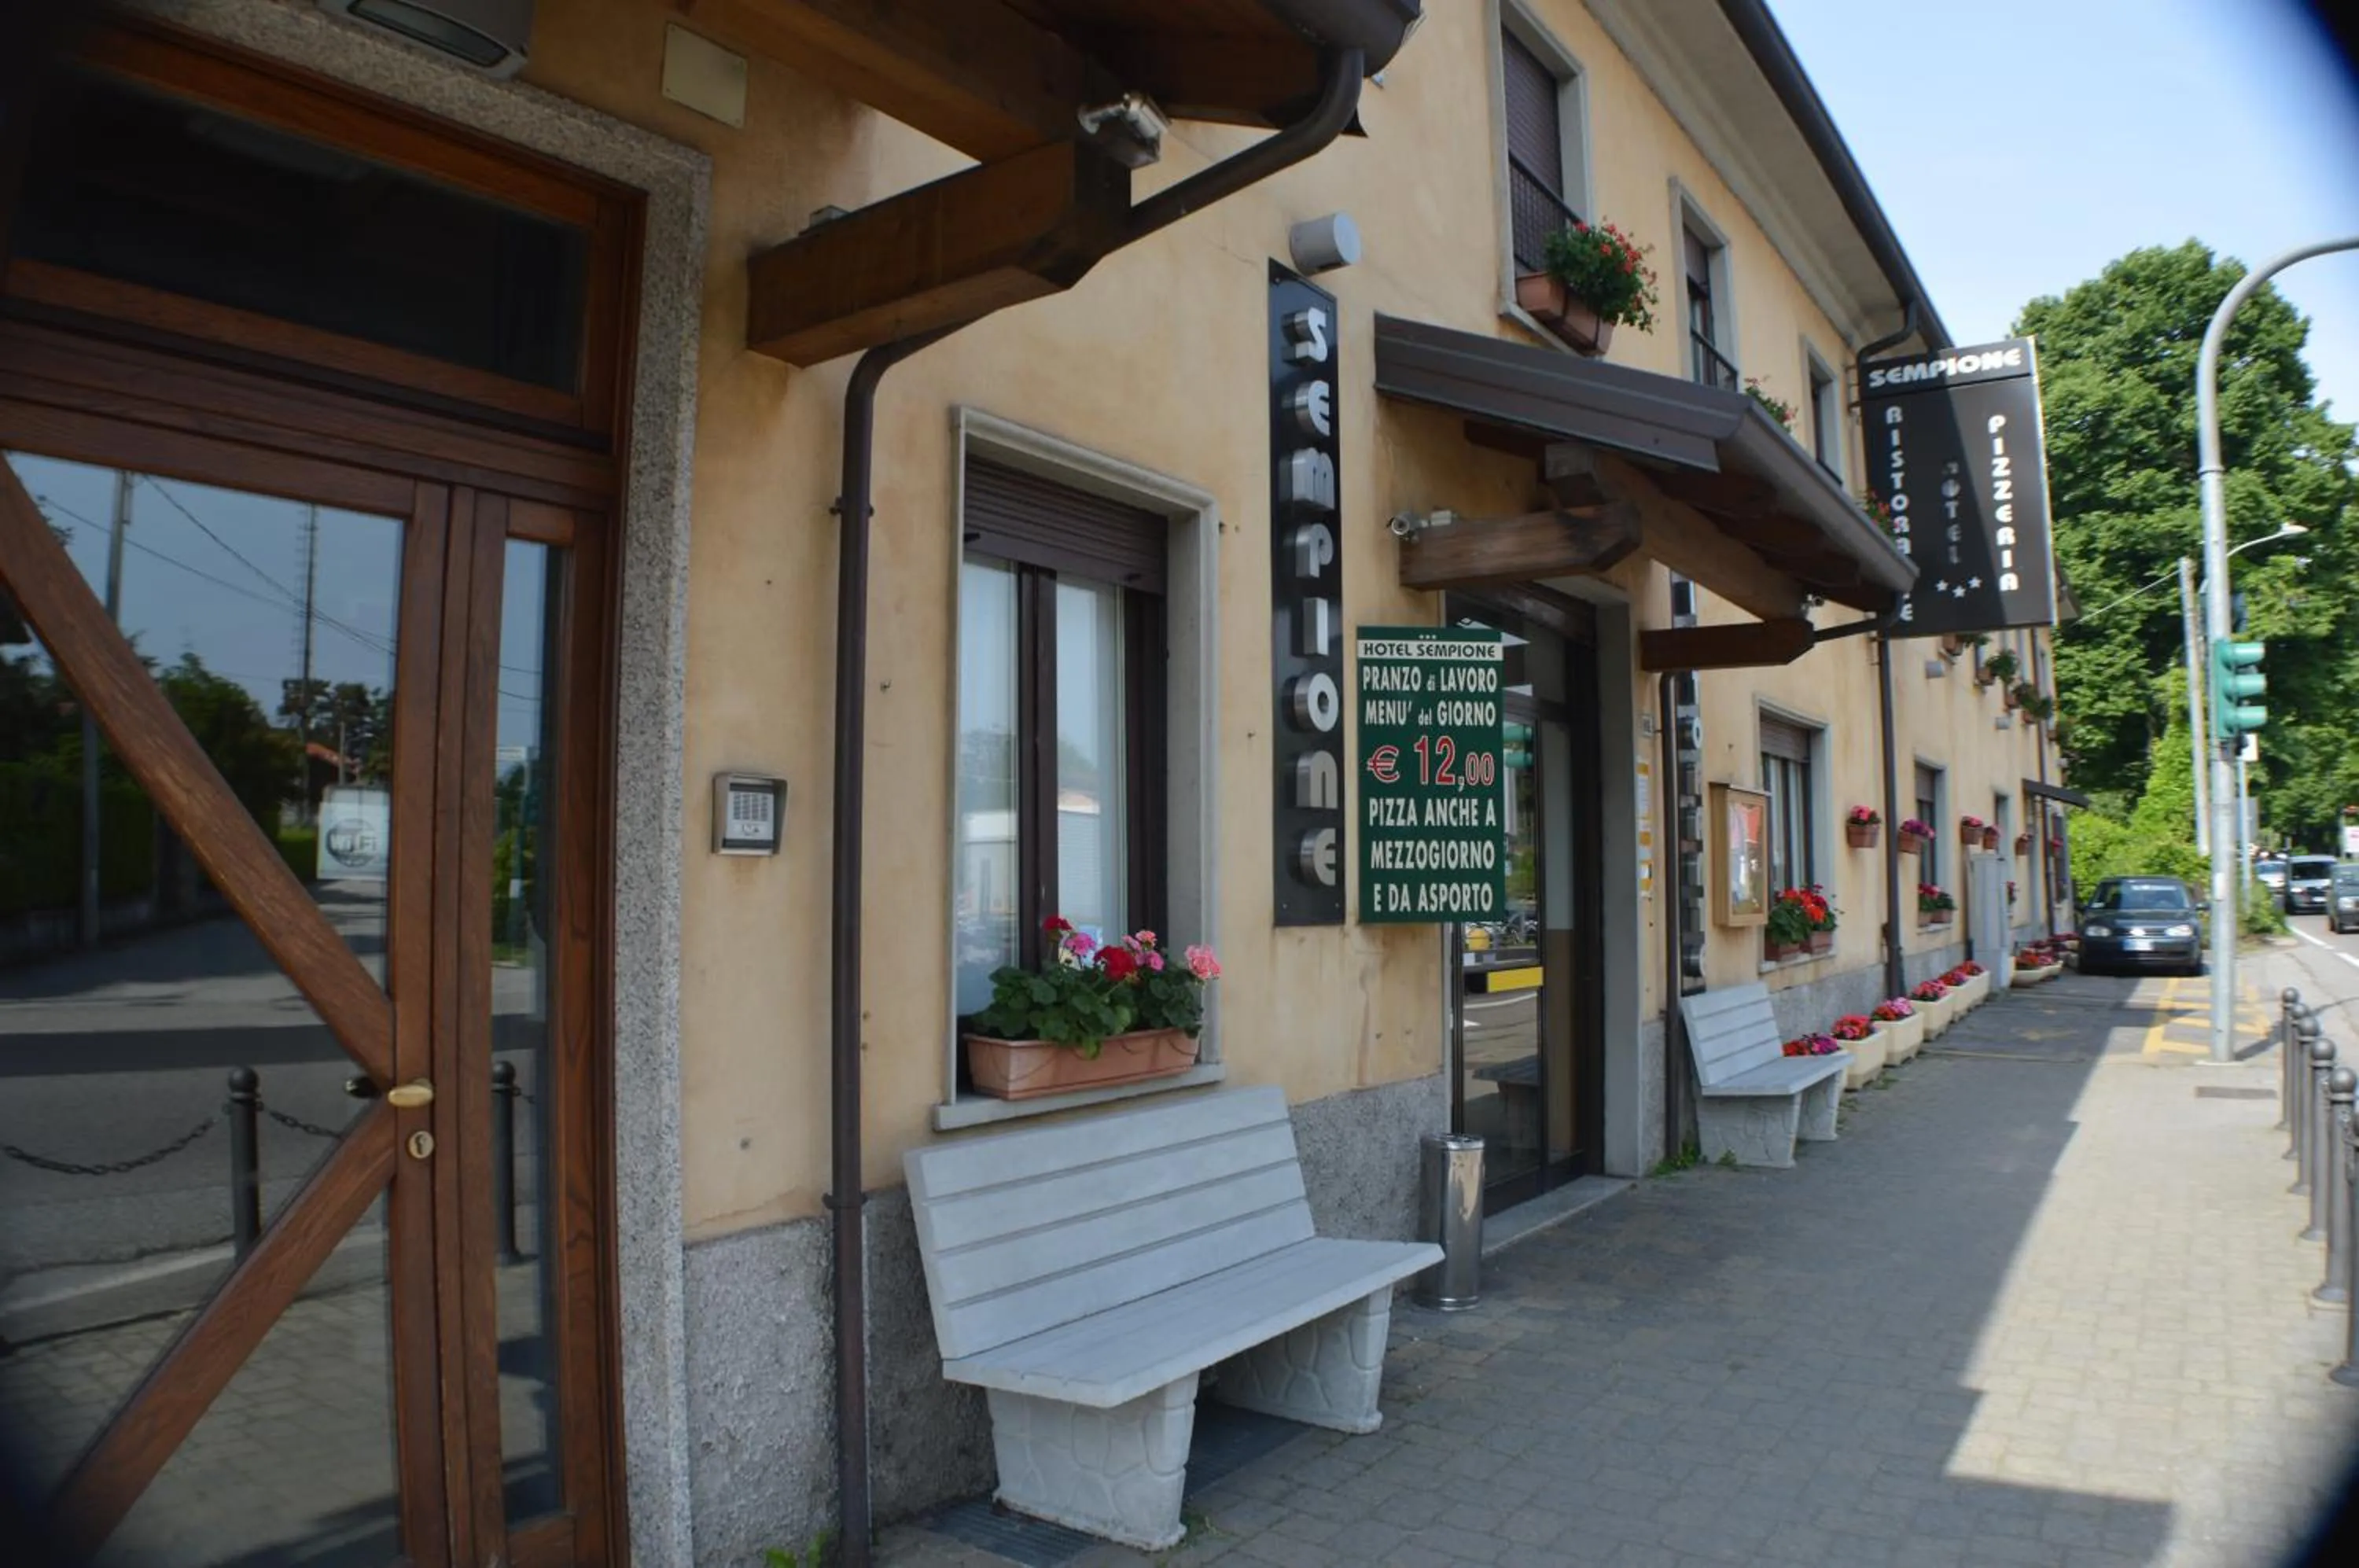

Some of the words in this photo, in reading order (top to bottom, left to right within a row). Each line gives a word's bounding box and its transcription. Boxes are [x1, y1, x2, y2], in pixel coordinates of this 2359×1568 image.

[1868, 348, 2022, 388] SEMPIONE
[1885, 406, 1914, 622] RISTORAE
[1987, 414, 2020, 591] PIZZERIA
[1364, 642, 1412, 657] HOTEL
[1416, 643, 1496, 658] SEMPIONE
[1363, 666, 1422, 693] PRANZO
[1426, 674, 1436, 692] di
[1440, 667, 1498, 694] LAVORO
[1418, 708, 1432, 727] del
[1437, 701, 1496, 727] GIORNO
[1367, 745, 1400, 784] €
[1414, 735, 1495, 791] 12,00
[1369, 797, 1416, 826] PIZZA
[1424, 797, 1478, 827] ANCHE
[1485, 798, 1496, 827] A
[1371, 839, 1495, 870] MEZZOGIORNO
[1373, 883, 1382, 912] E
[1388, 883, 1411, 913] DA
[1418, 882, 1493, 913] ASPORTO
